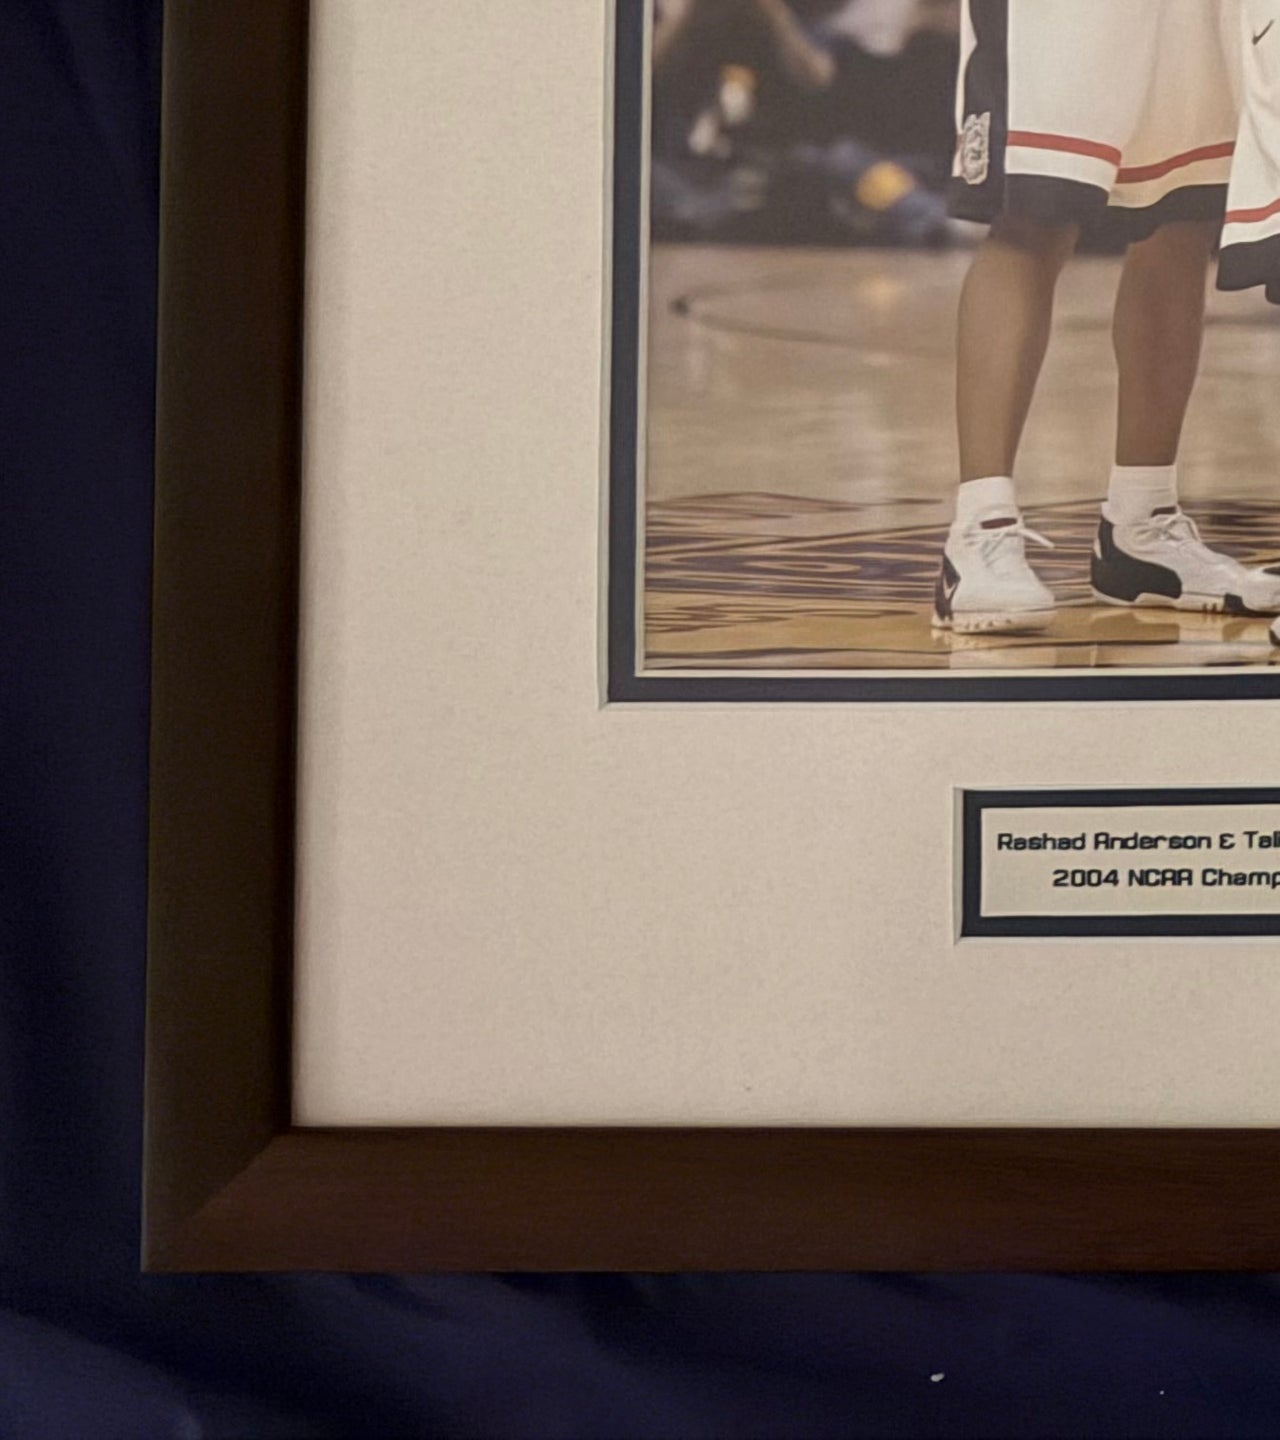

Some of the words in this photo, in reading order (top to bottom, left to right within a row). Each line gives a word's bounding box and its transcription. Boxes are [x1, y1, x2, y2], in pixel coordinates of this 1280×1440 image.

[996, 831, 1087, 851] Rashad
[1092, 831, 1213, 851] Anderson
[1218, 832, 1237, 851] &
[1051, 868, 1120, 888] 2004
[1127, 867, 1195, 887] NCAA
